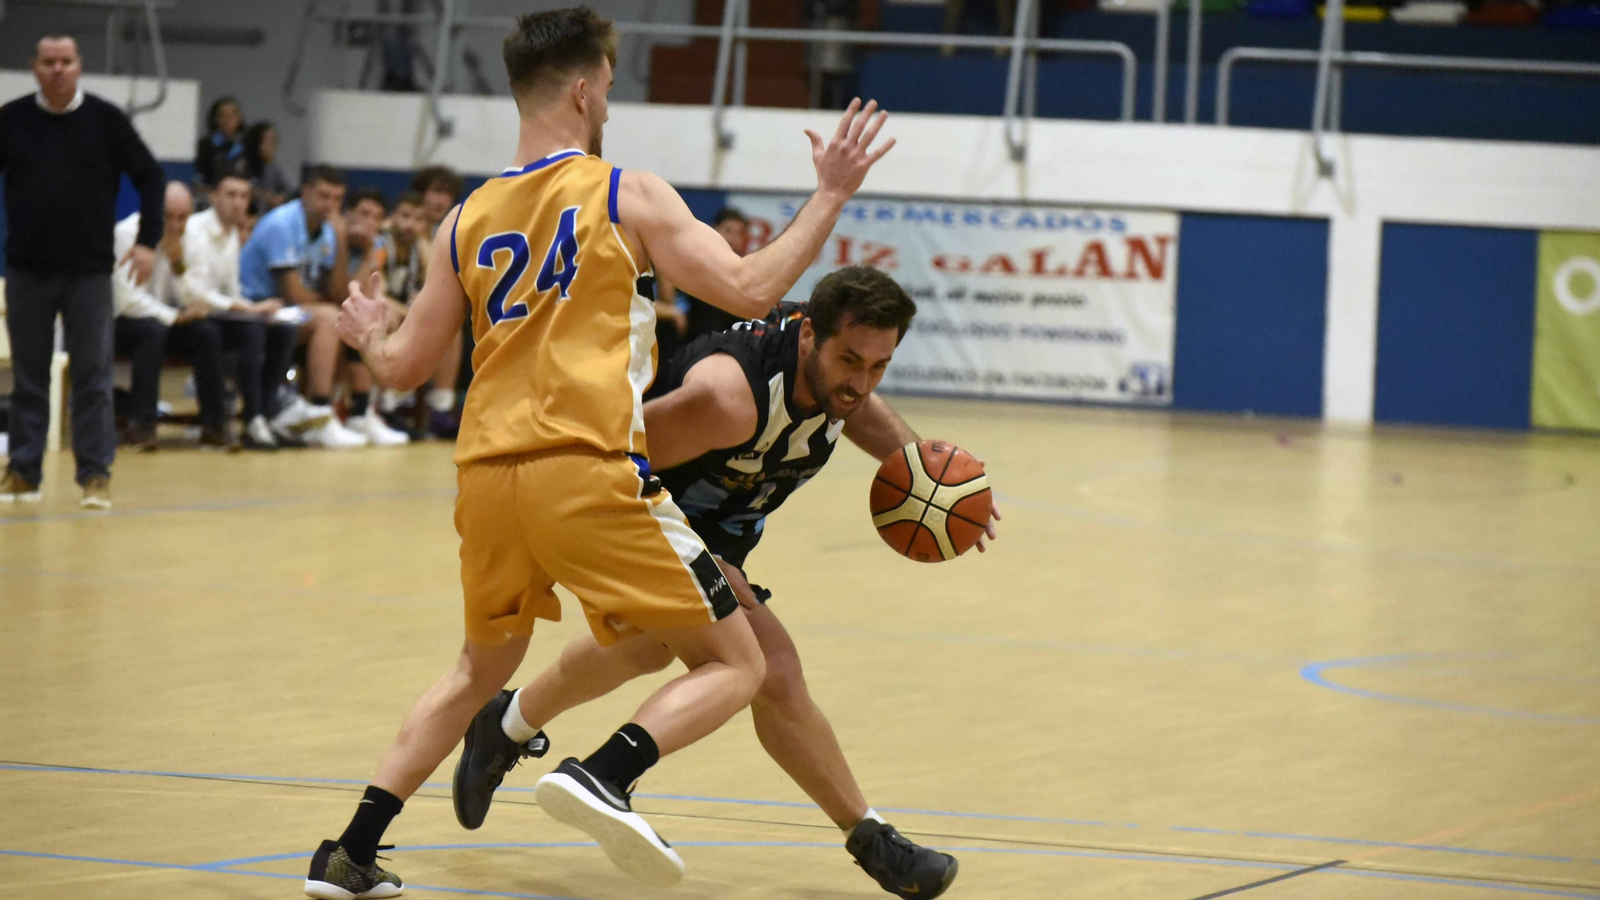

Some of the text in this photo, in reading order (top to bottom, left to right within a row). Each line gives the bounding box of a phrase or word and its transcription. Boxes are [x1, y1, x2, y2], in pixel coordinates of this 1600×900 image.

[475, 205, 582, 325] 24
[742, 216, 1173, 281] RIZ GALAN
